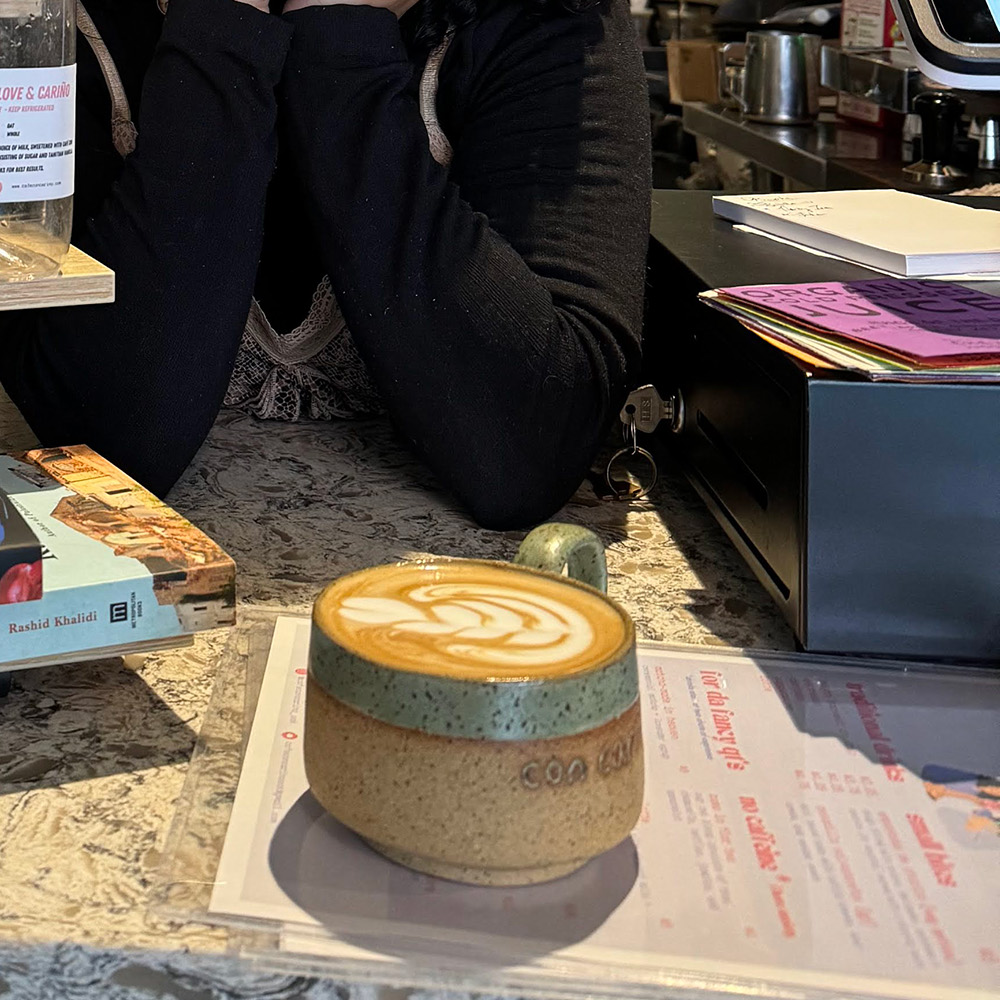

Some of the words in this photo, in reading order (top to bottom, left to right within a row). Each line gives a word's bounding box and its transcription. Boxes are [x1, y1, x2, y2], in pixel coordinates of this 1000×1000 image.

[26, 86, 35, 100] &
[37, 81, 70, 99] CARIÑO
[741, 280, 951, 298] ORGANIC
[9, 618, 50, 634] Rashid
[54, 611, 97, 627] Khalidi
